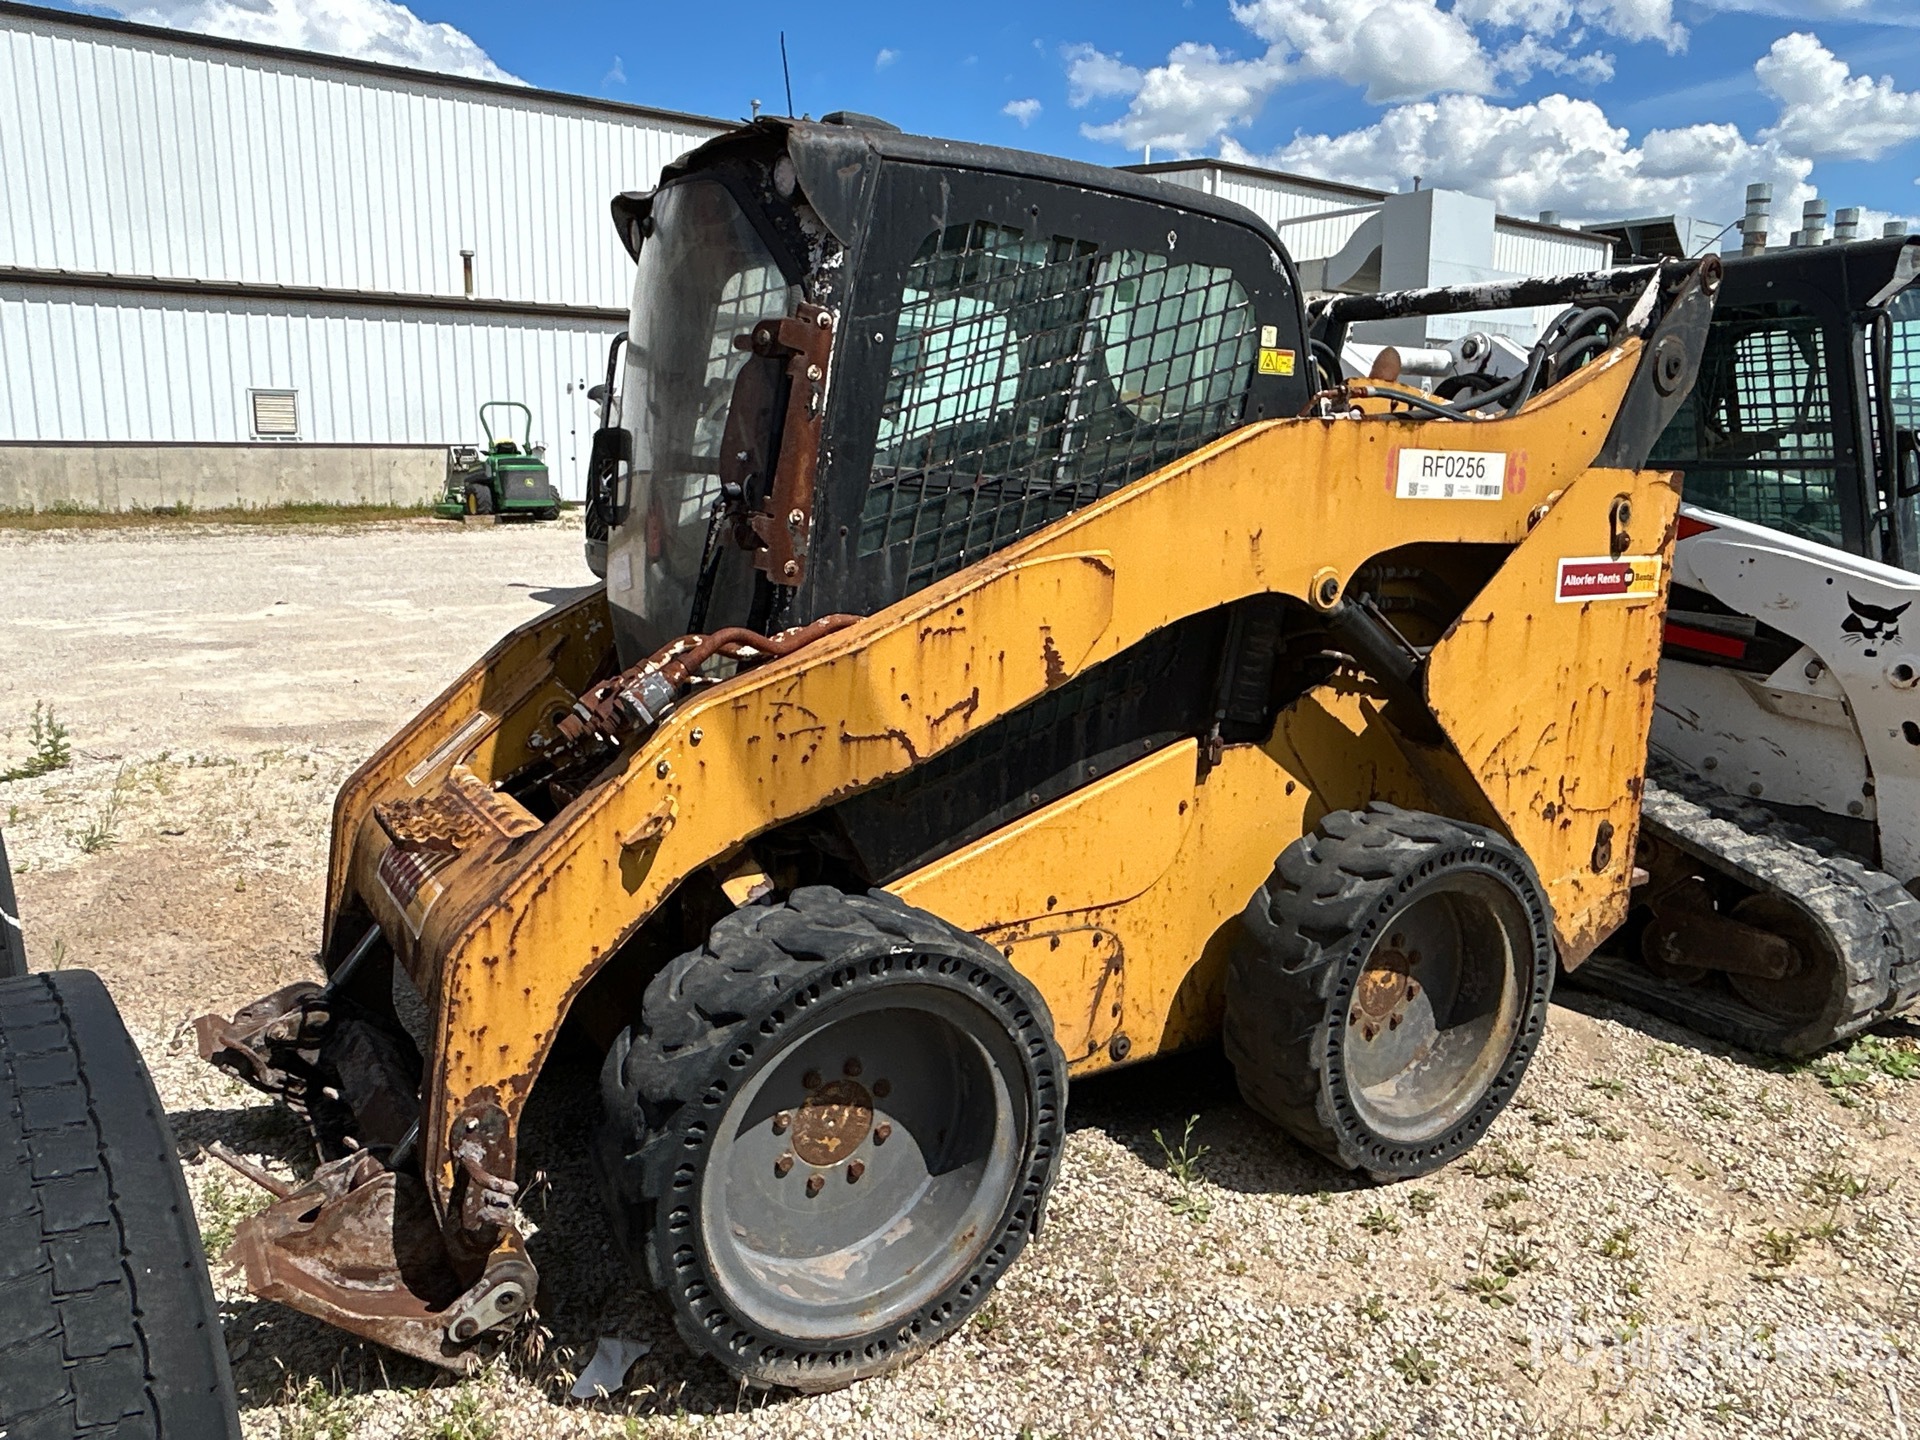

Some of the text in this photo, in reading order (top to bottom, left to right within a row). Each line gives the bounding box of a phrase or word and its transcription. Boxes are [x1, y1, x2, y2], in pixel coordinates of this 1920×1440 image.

[1422, 456, 1485, 478] RF0256
[1564, 574, 1596, 586] Altorfer
[1597, 573, 1621, 584] Rents
